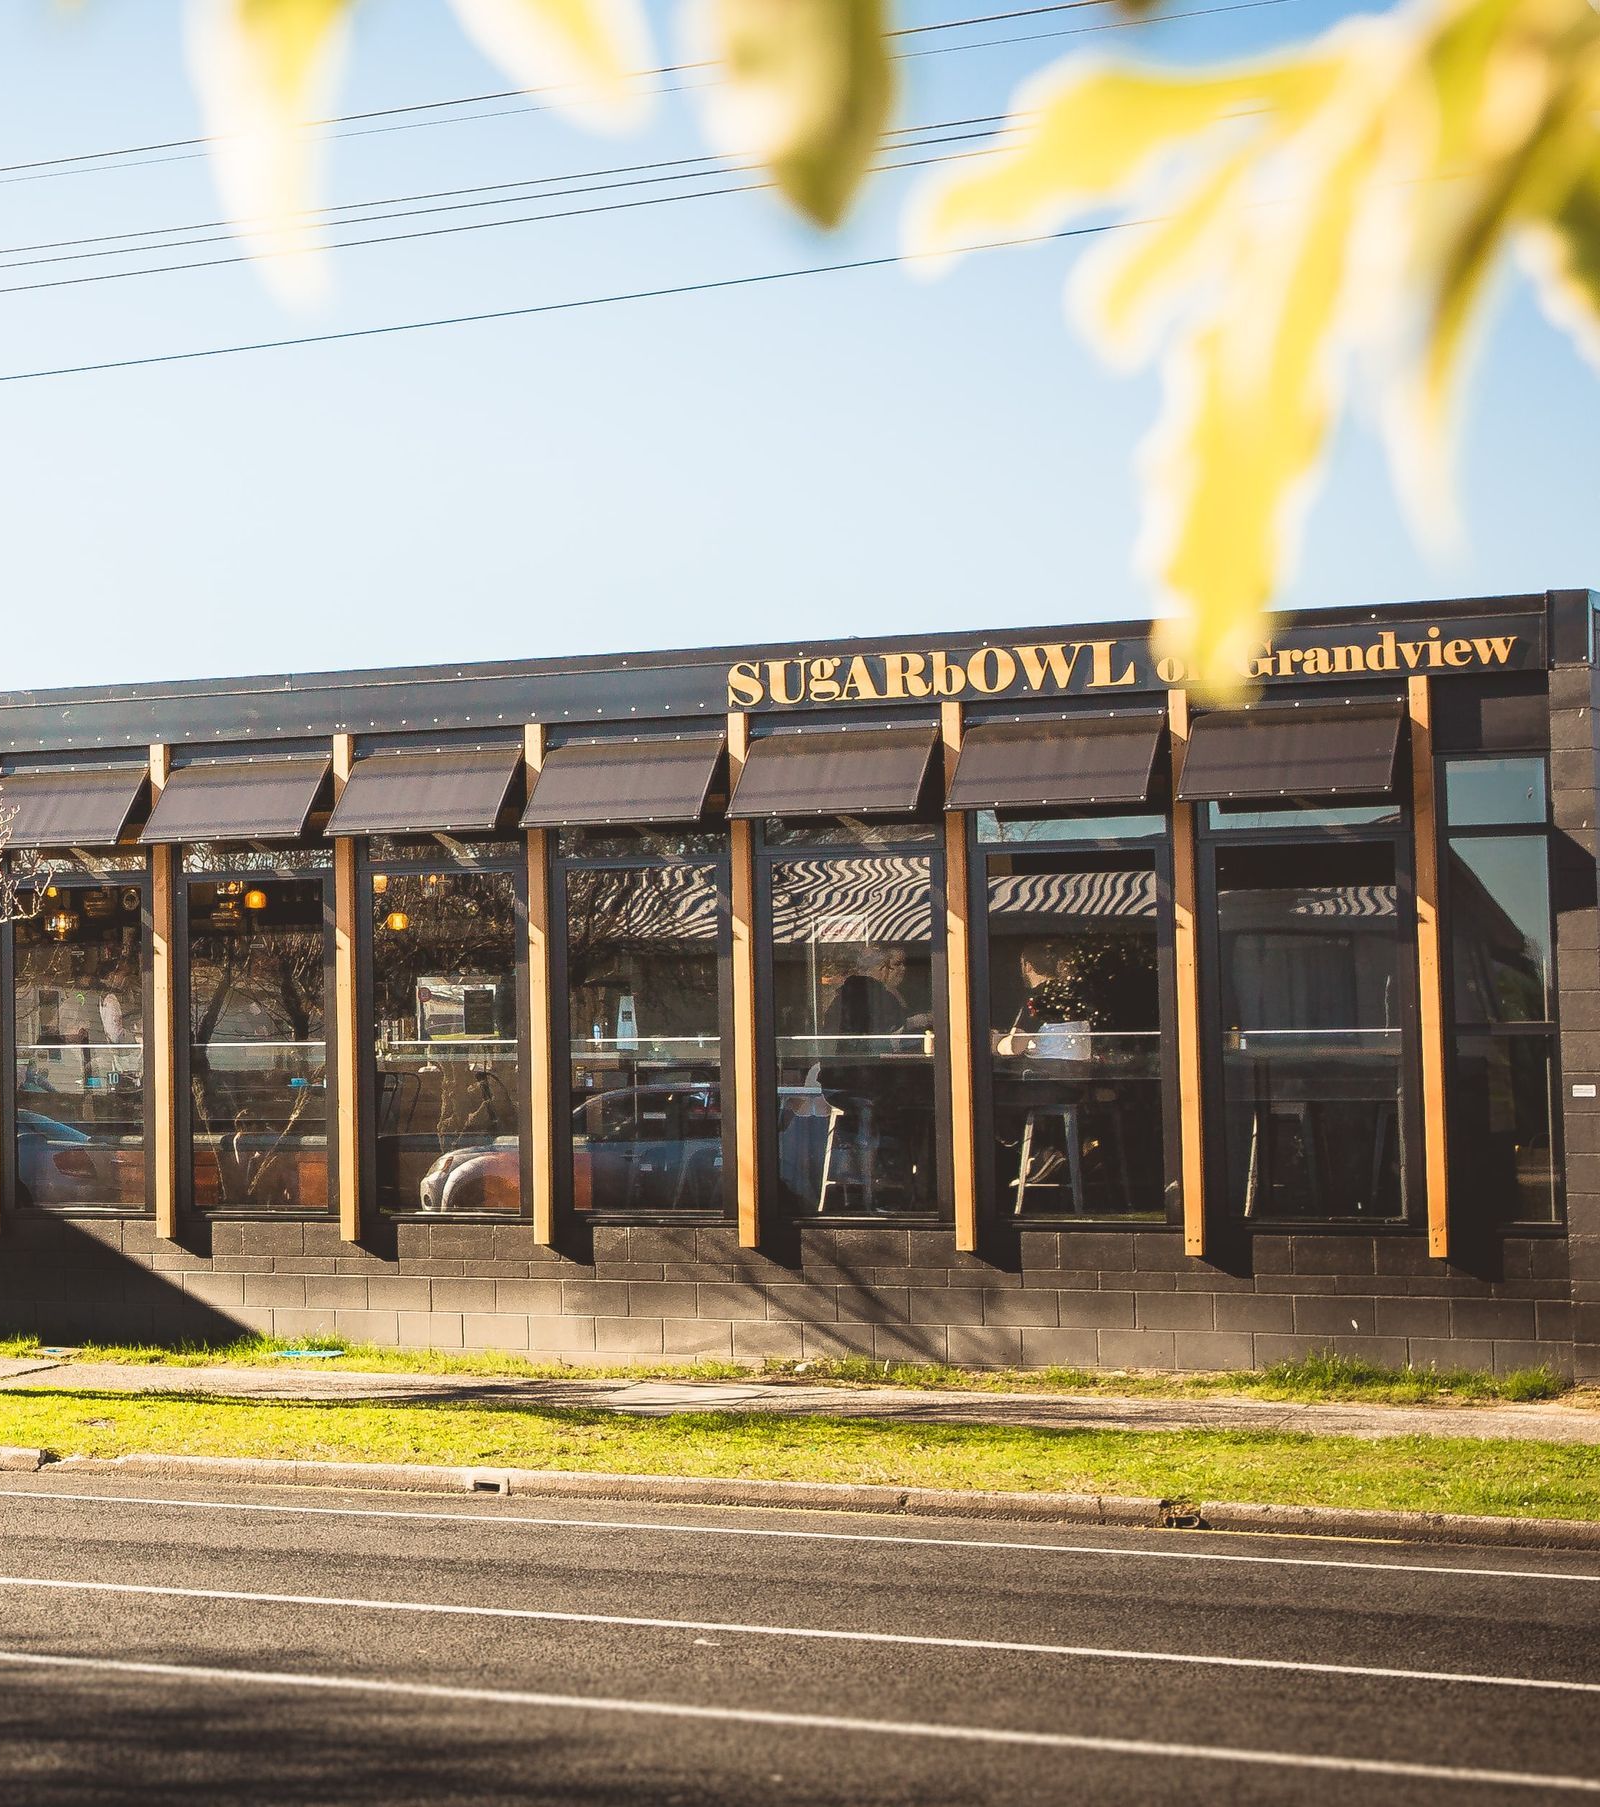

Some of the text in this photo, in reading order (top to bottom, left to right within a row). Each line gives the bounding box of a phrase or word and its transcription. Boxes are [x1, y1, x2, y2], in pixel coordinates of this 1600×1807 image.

[727, 640, 1136, 707] SUgARbOWL
[1238, 626, 1518, 679] Grandview
[108, 1072, 119, 1085] 10
